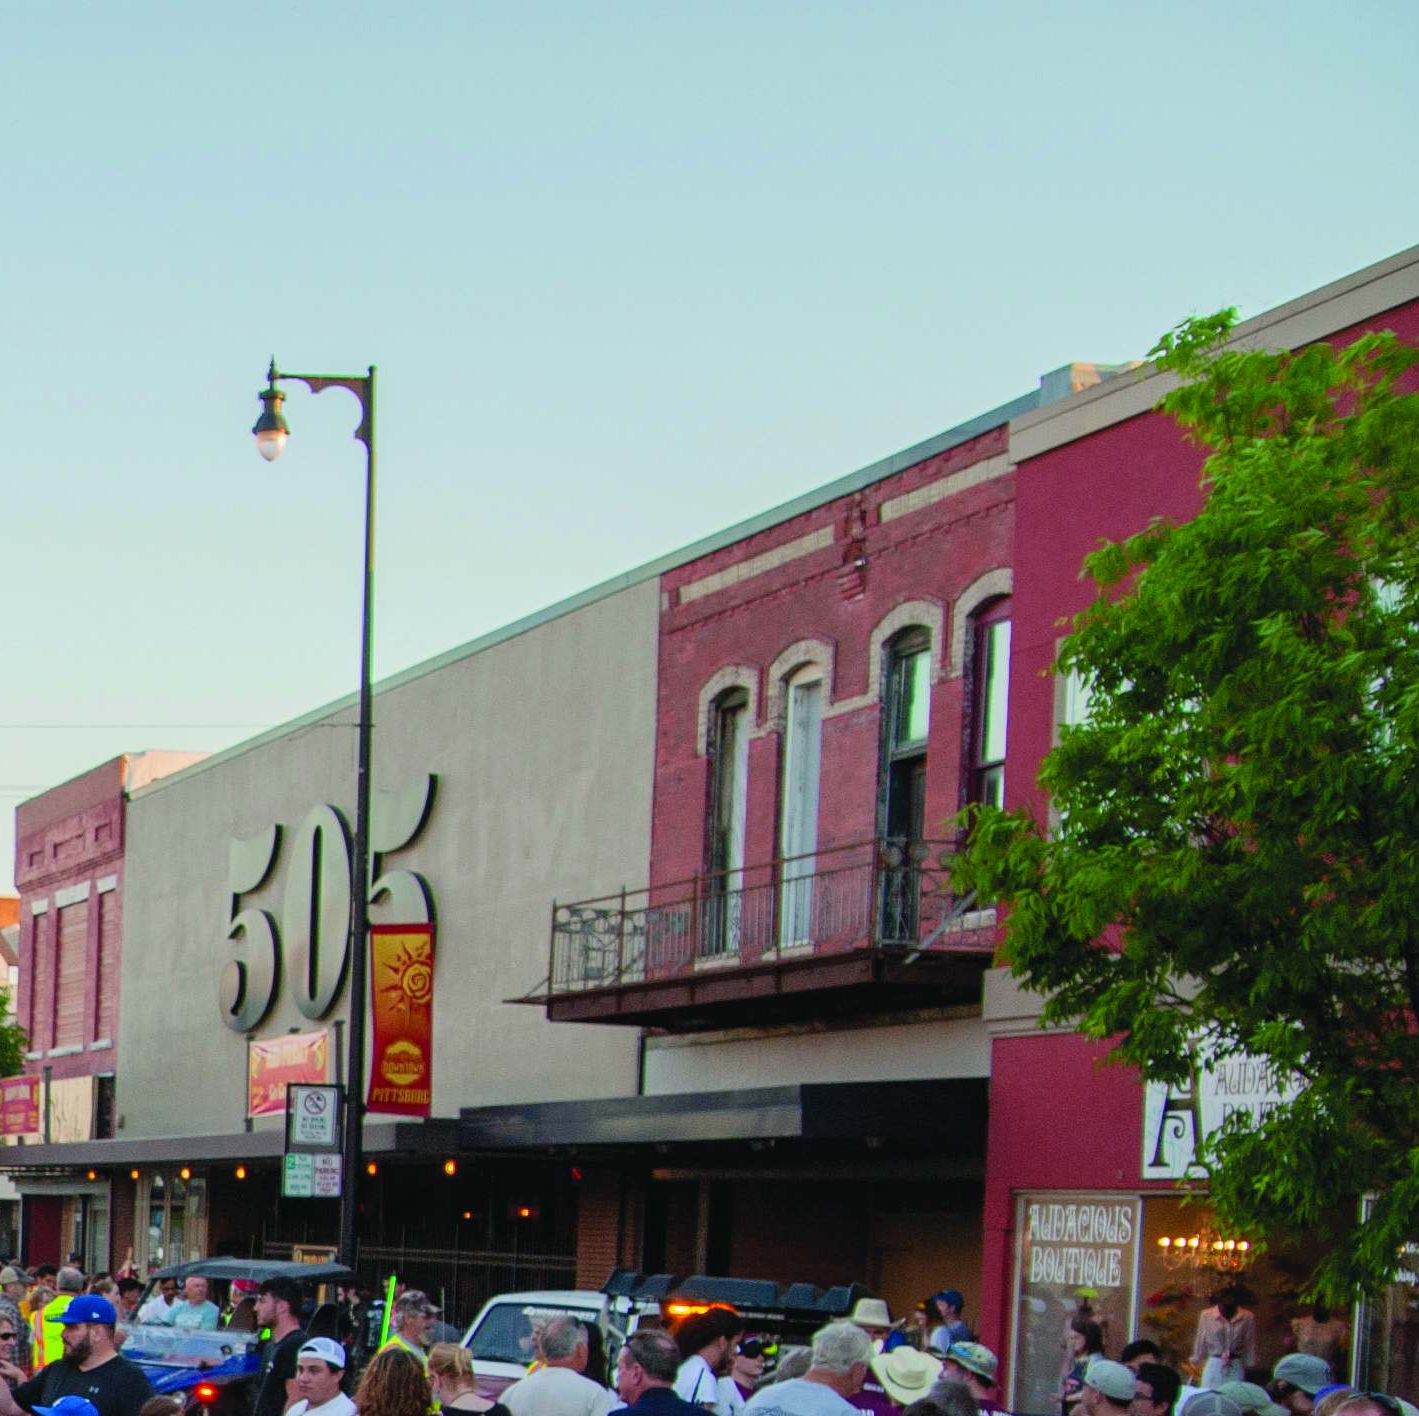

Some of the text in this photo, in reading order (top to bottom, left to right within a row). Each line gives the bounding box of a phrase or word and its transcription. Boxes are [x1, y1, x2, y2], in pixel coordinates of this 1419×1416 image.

[382, 1061, 425, 1074] DOWNTOWN
[372, 1088, 430, 1105] PITTSBURG
[1028, 1204, 1132, 1244] AUDACIOUS
[1030, 1246, 1122, 1288] BOUTIQUE
